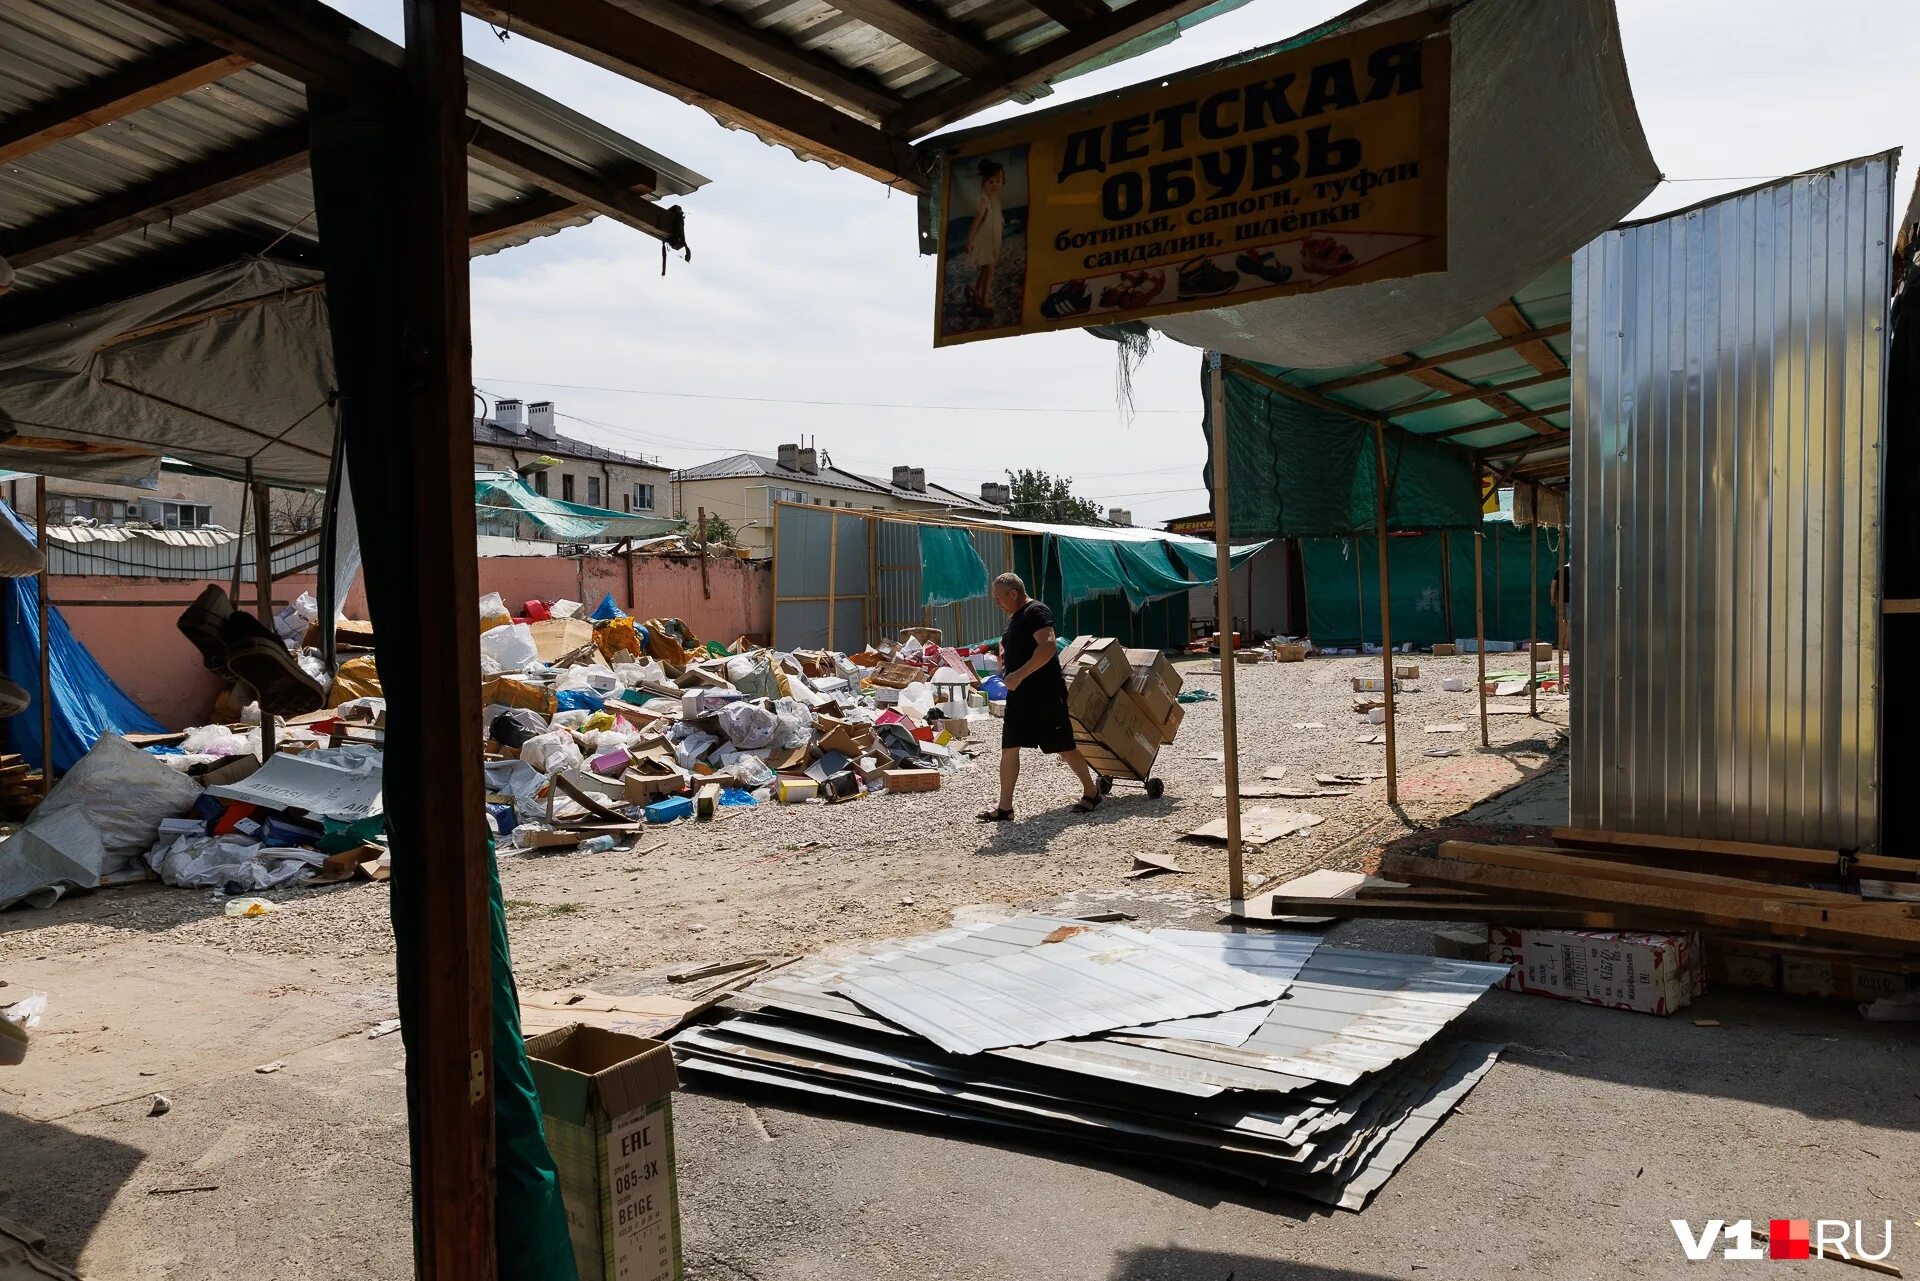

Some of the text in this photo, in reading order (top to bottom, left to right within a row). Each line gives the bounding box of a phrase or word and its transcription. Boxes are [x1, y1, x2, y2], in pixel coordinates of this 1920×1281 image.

[1056, 39, 1424, 184] ДЕТСКАЯ
[1054, 160, 1420, 252] ботинки, сапоги, туфли
[1102, 123, 1363, 222] ОБУВЬ
[1082, 202, 1361, 271] сандалии, шлёпки
[621, 1126, 652, 1158] EAC
[616, 1160, 659, 1195] 085-3X
[618, 1194, 653, 1226] BEIGE
